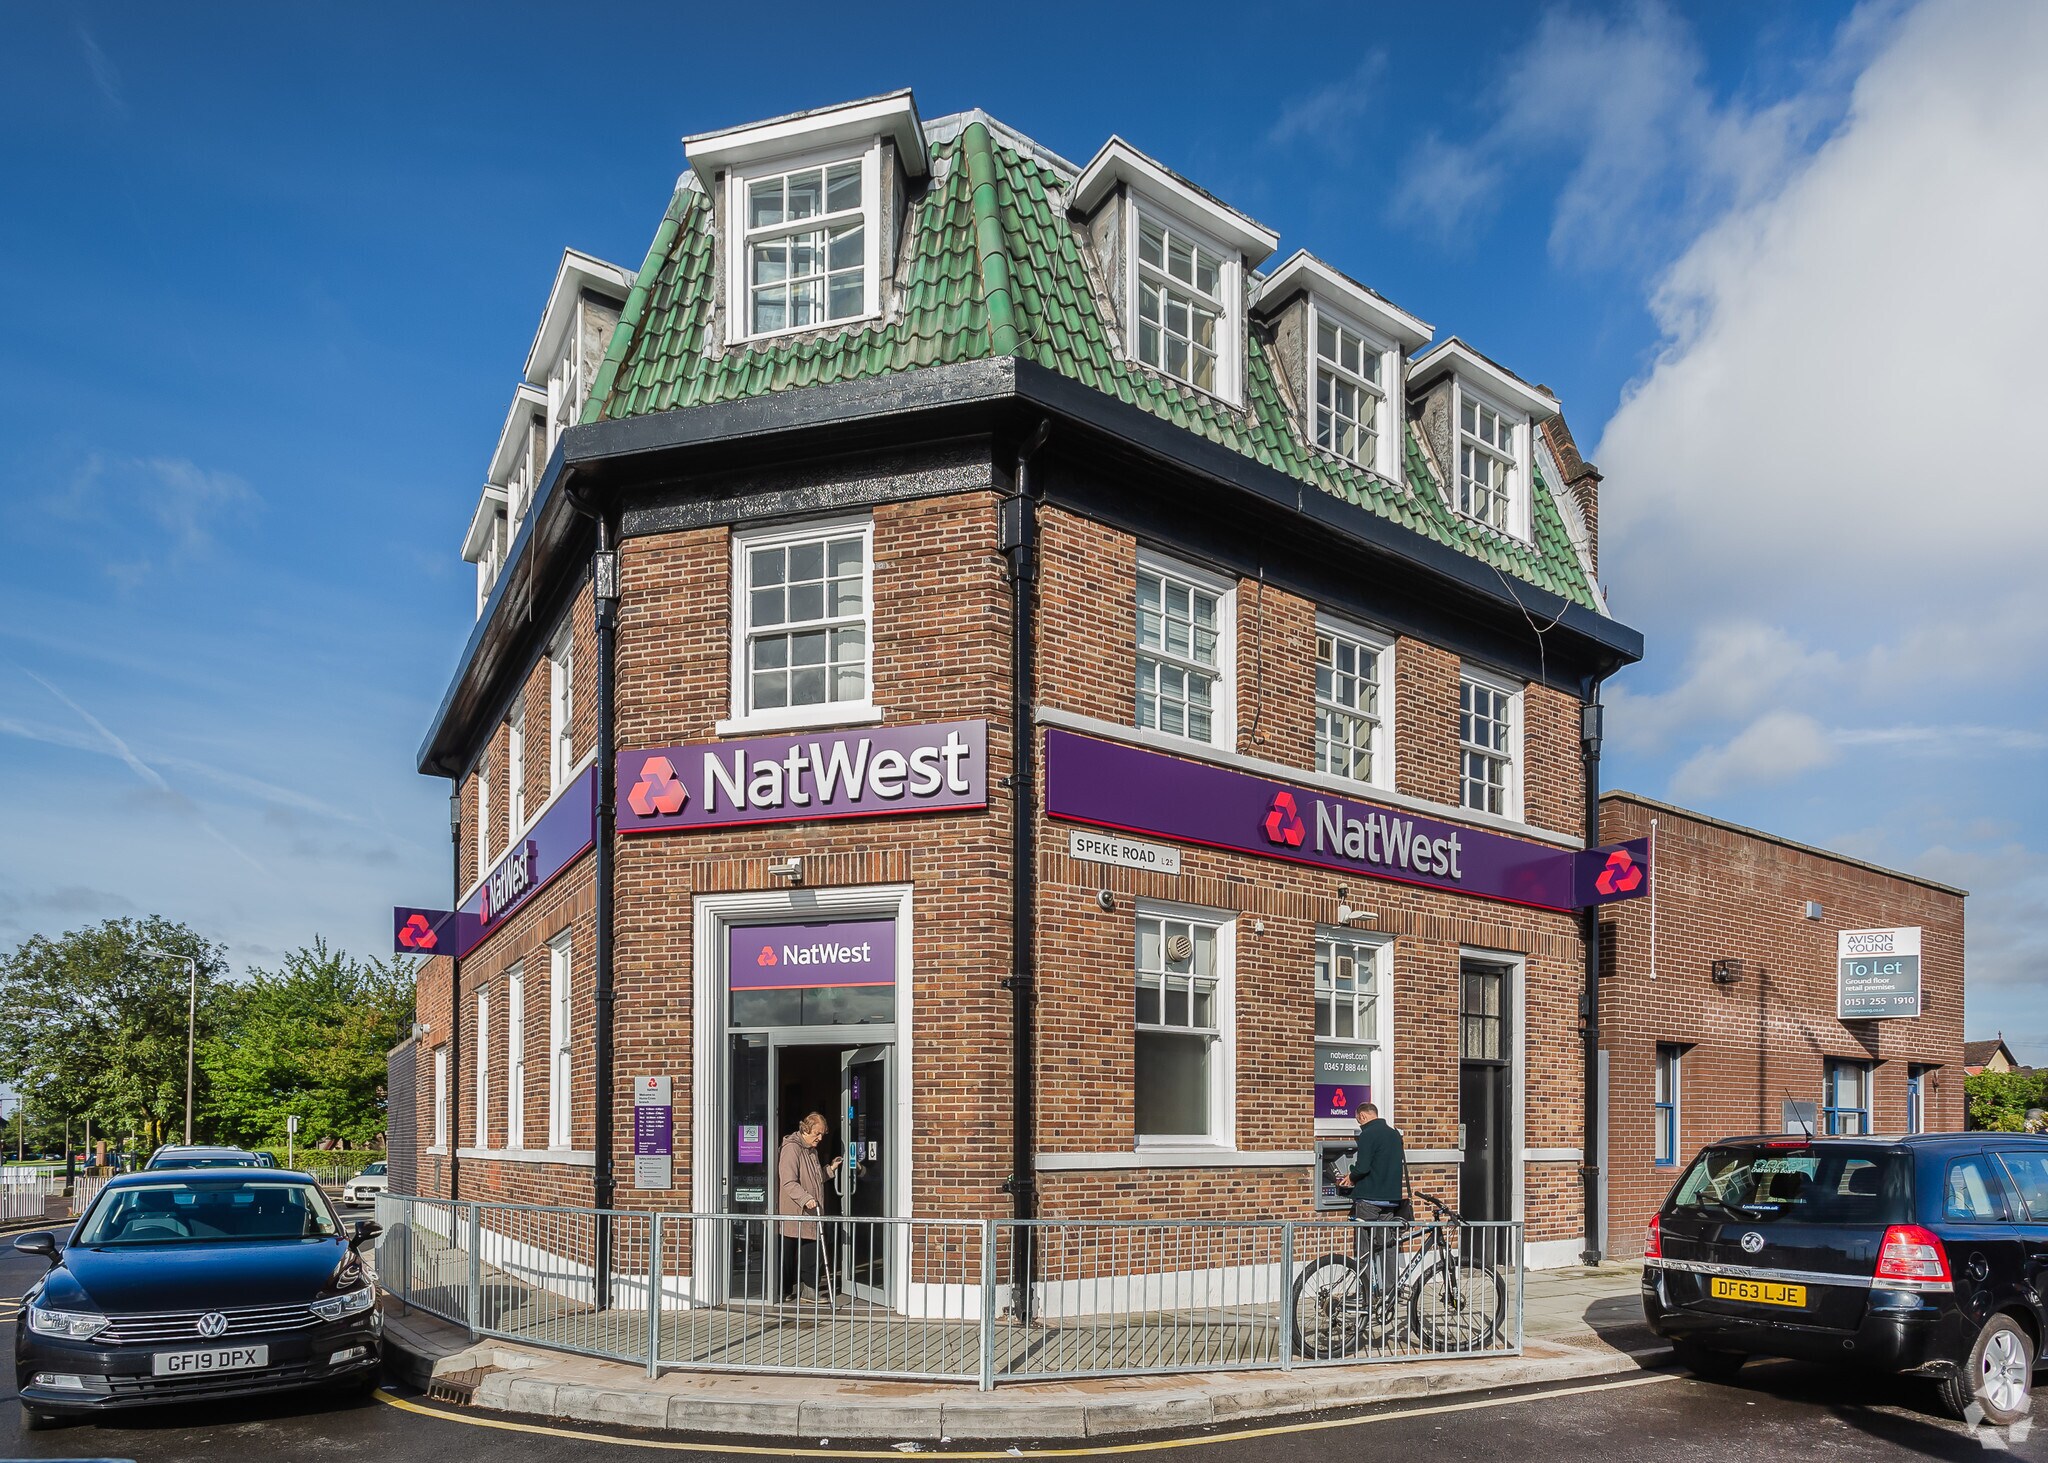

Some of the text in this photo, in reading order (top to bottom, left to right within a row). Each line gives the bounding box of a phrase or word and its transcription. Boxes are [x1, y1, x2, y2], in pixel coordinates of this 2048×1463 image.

[704, 730, 970, 812] NatWest
[1316, 800, 1462, 879] NatWest
[1076, 838, 1174, 866] SPEKE ROAD L25
[489, 840, 529, 918] NatWest
[1847, 934, 1894, 944] AVISON
[783, 942, 871, 966] NatWest
[1847, 943, 1894, 953] YOUNG
[1845, 961, 1903, 976] To Let
[1864, 984, 1896, 992] premises
[1844, 996, 1915, 1006] 0151 255 1910
[1330, 1052, 1369, 1060] natwest.com
[1323, 1062, 1368, 1072] 0345 7 888 444
[1330, 1108, 1349, 1116] NatWest
[1718, 1281, 1798, 1303] DF63 LJE
[168, 1349, 257, 1372] GF19 DPX
